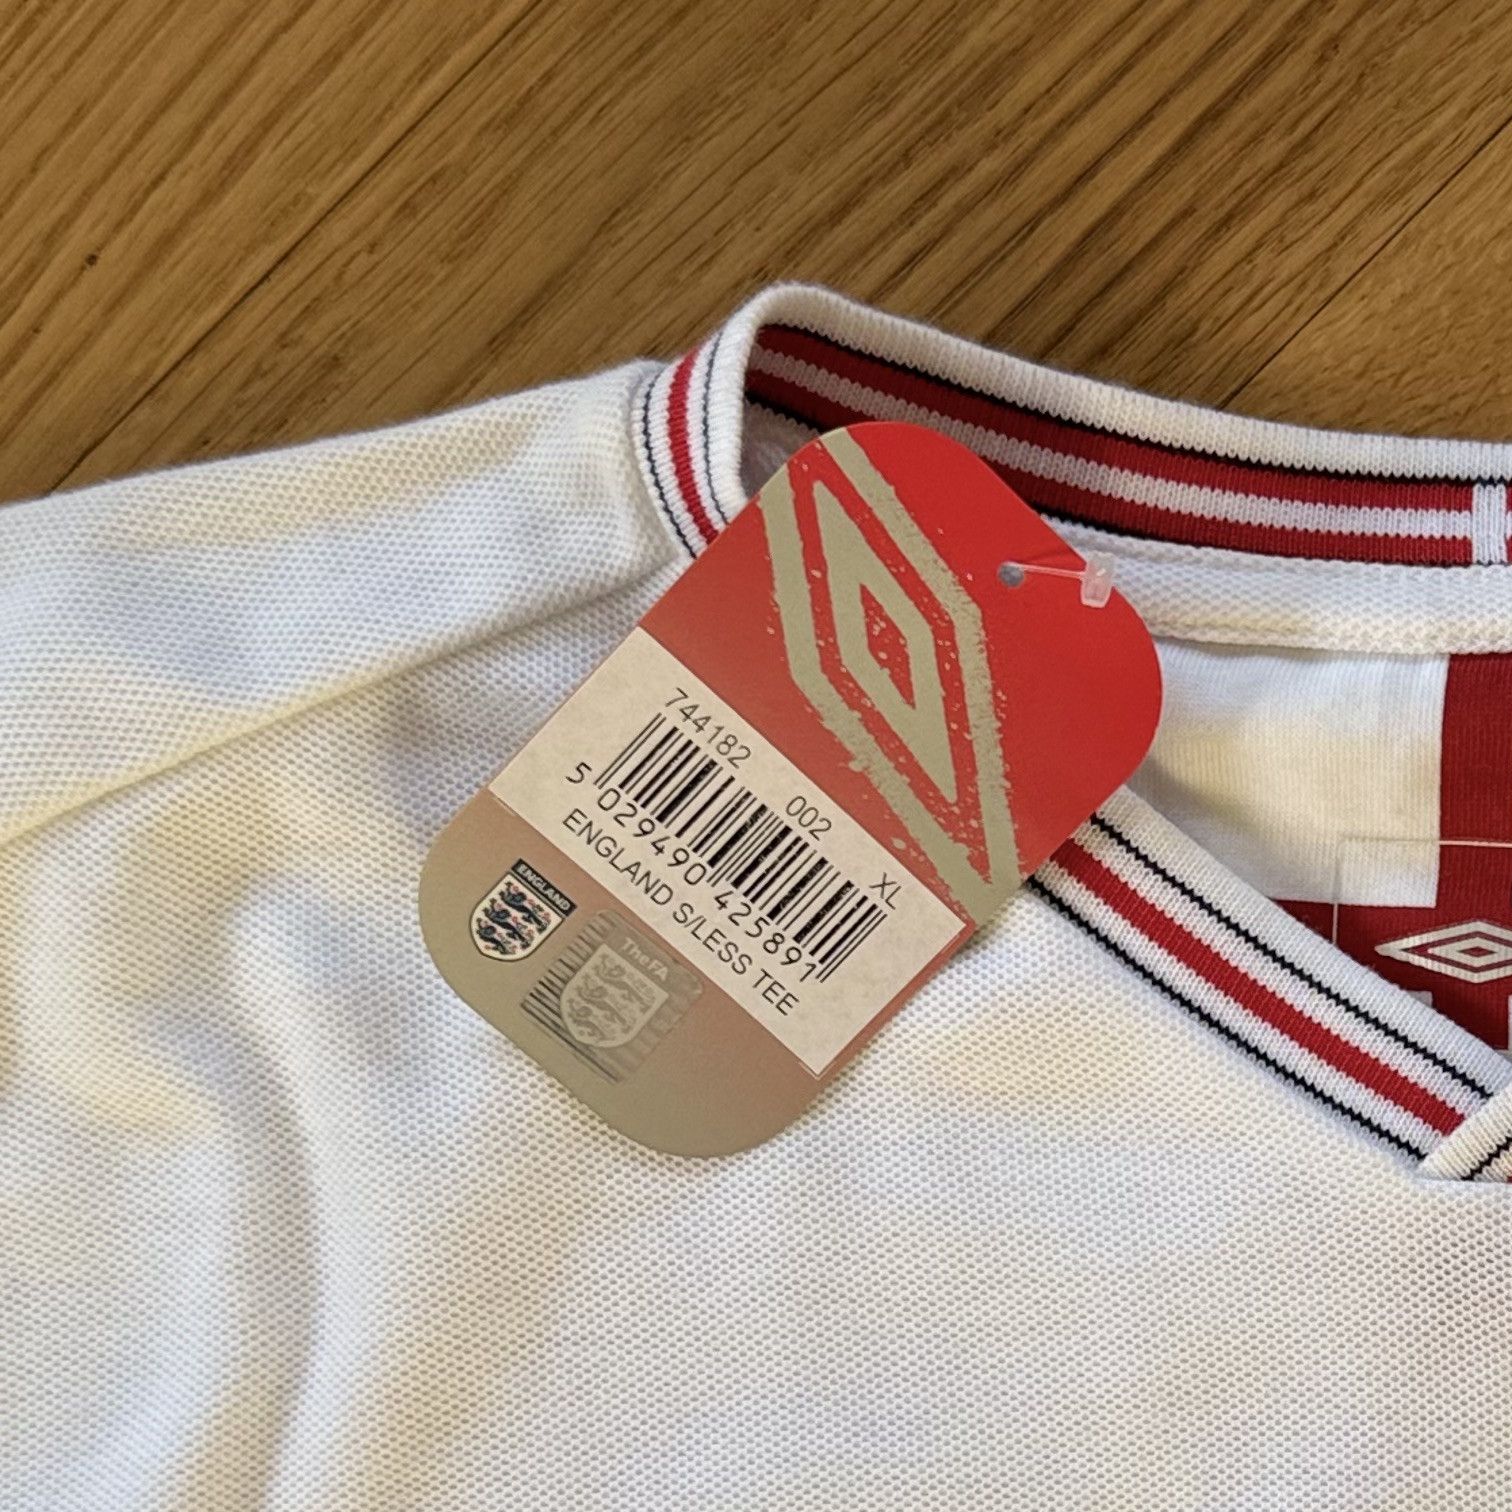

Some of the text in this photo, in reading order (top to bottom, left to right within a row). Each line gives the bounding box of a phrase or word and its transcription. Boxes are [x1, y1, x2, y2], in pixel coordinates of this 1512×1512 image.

[516, 863, 571, 913] ENGLAND
[565, 762, 819, 983] 5 029490 425891
[665, 687, 905, 910] 744182 002 XL
[561, 808, 800, 1017] ENGLAND S/LESS TEE
